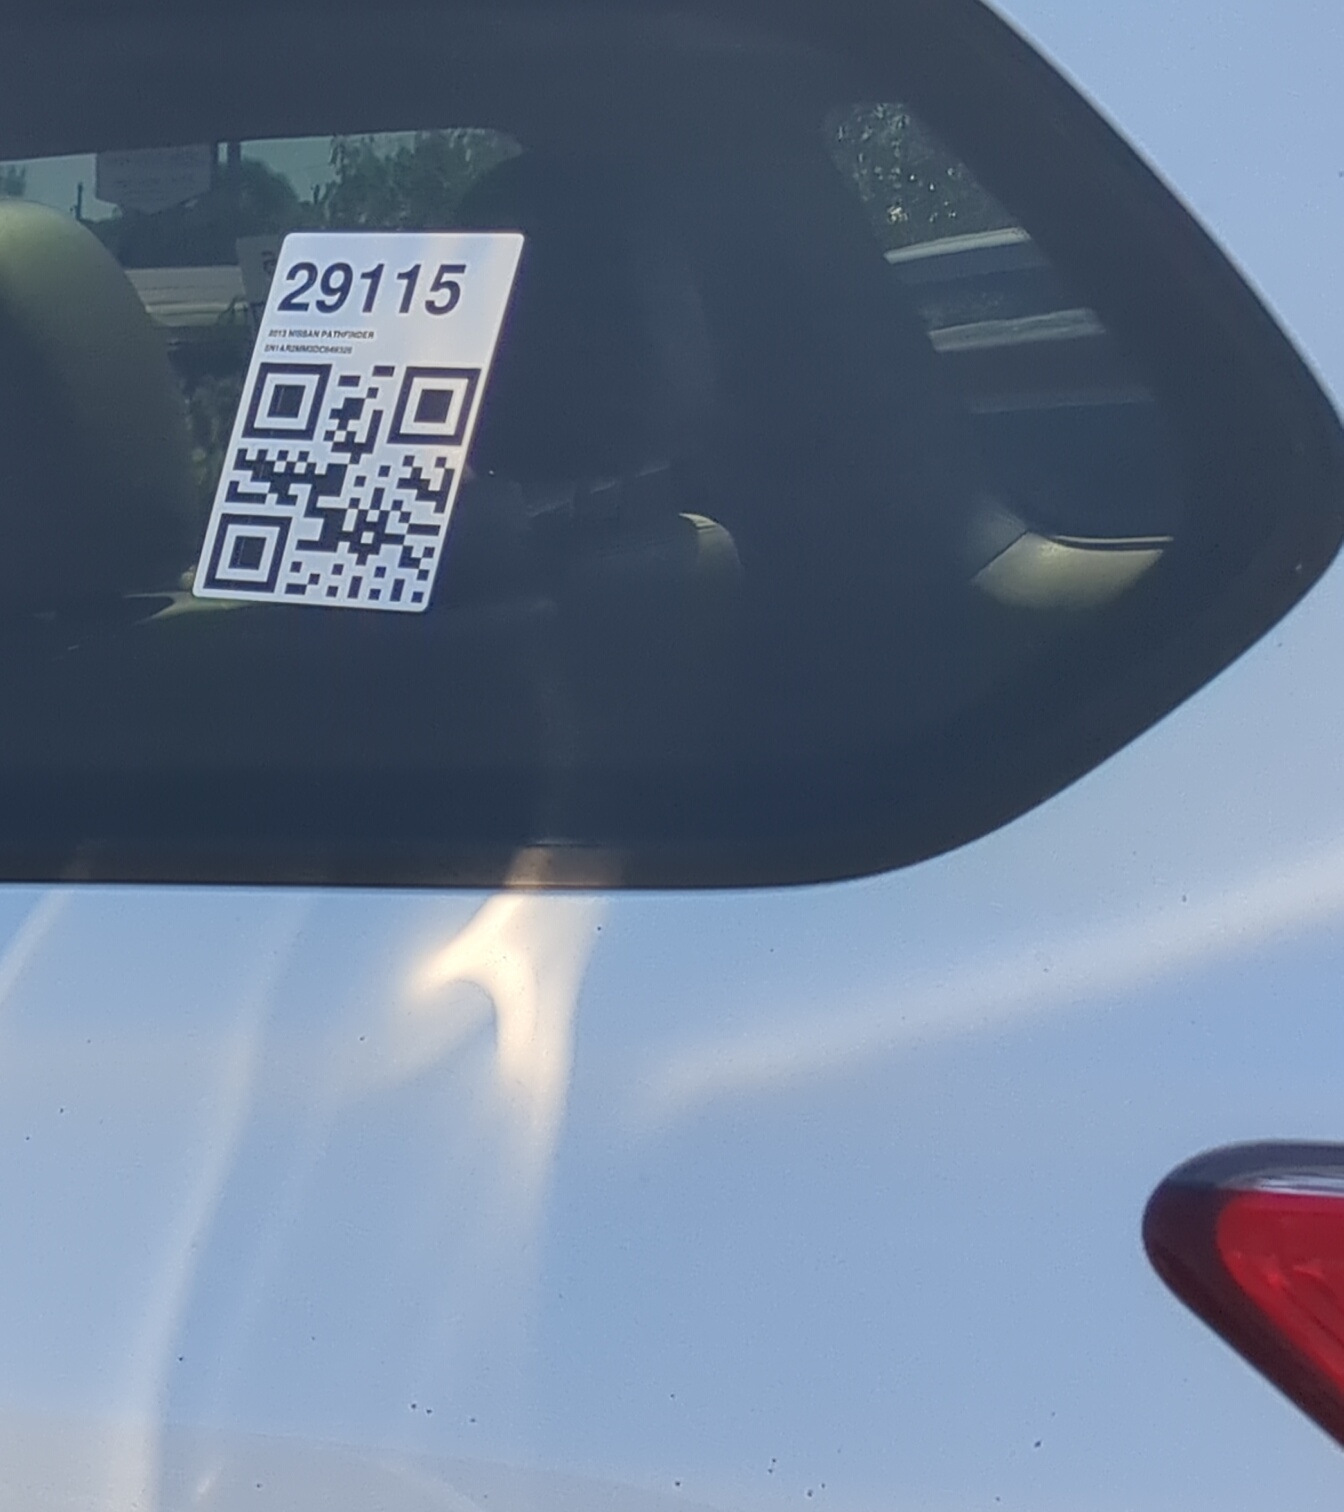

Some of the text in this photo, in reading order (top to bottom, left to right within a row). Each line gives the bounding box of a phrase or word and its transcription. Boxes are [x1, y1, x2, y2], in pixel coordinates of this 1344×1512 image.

[278, 261, 467, 316] 29115
[288, 329, 320, 338] NISSAN
[321, 330, 375, 339] PATHFINDER
